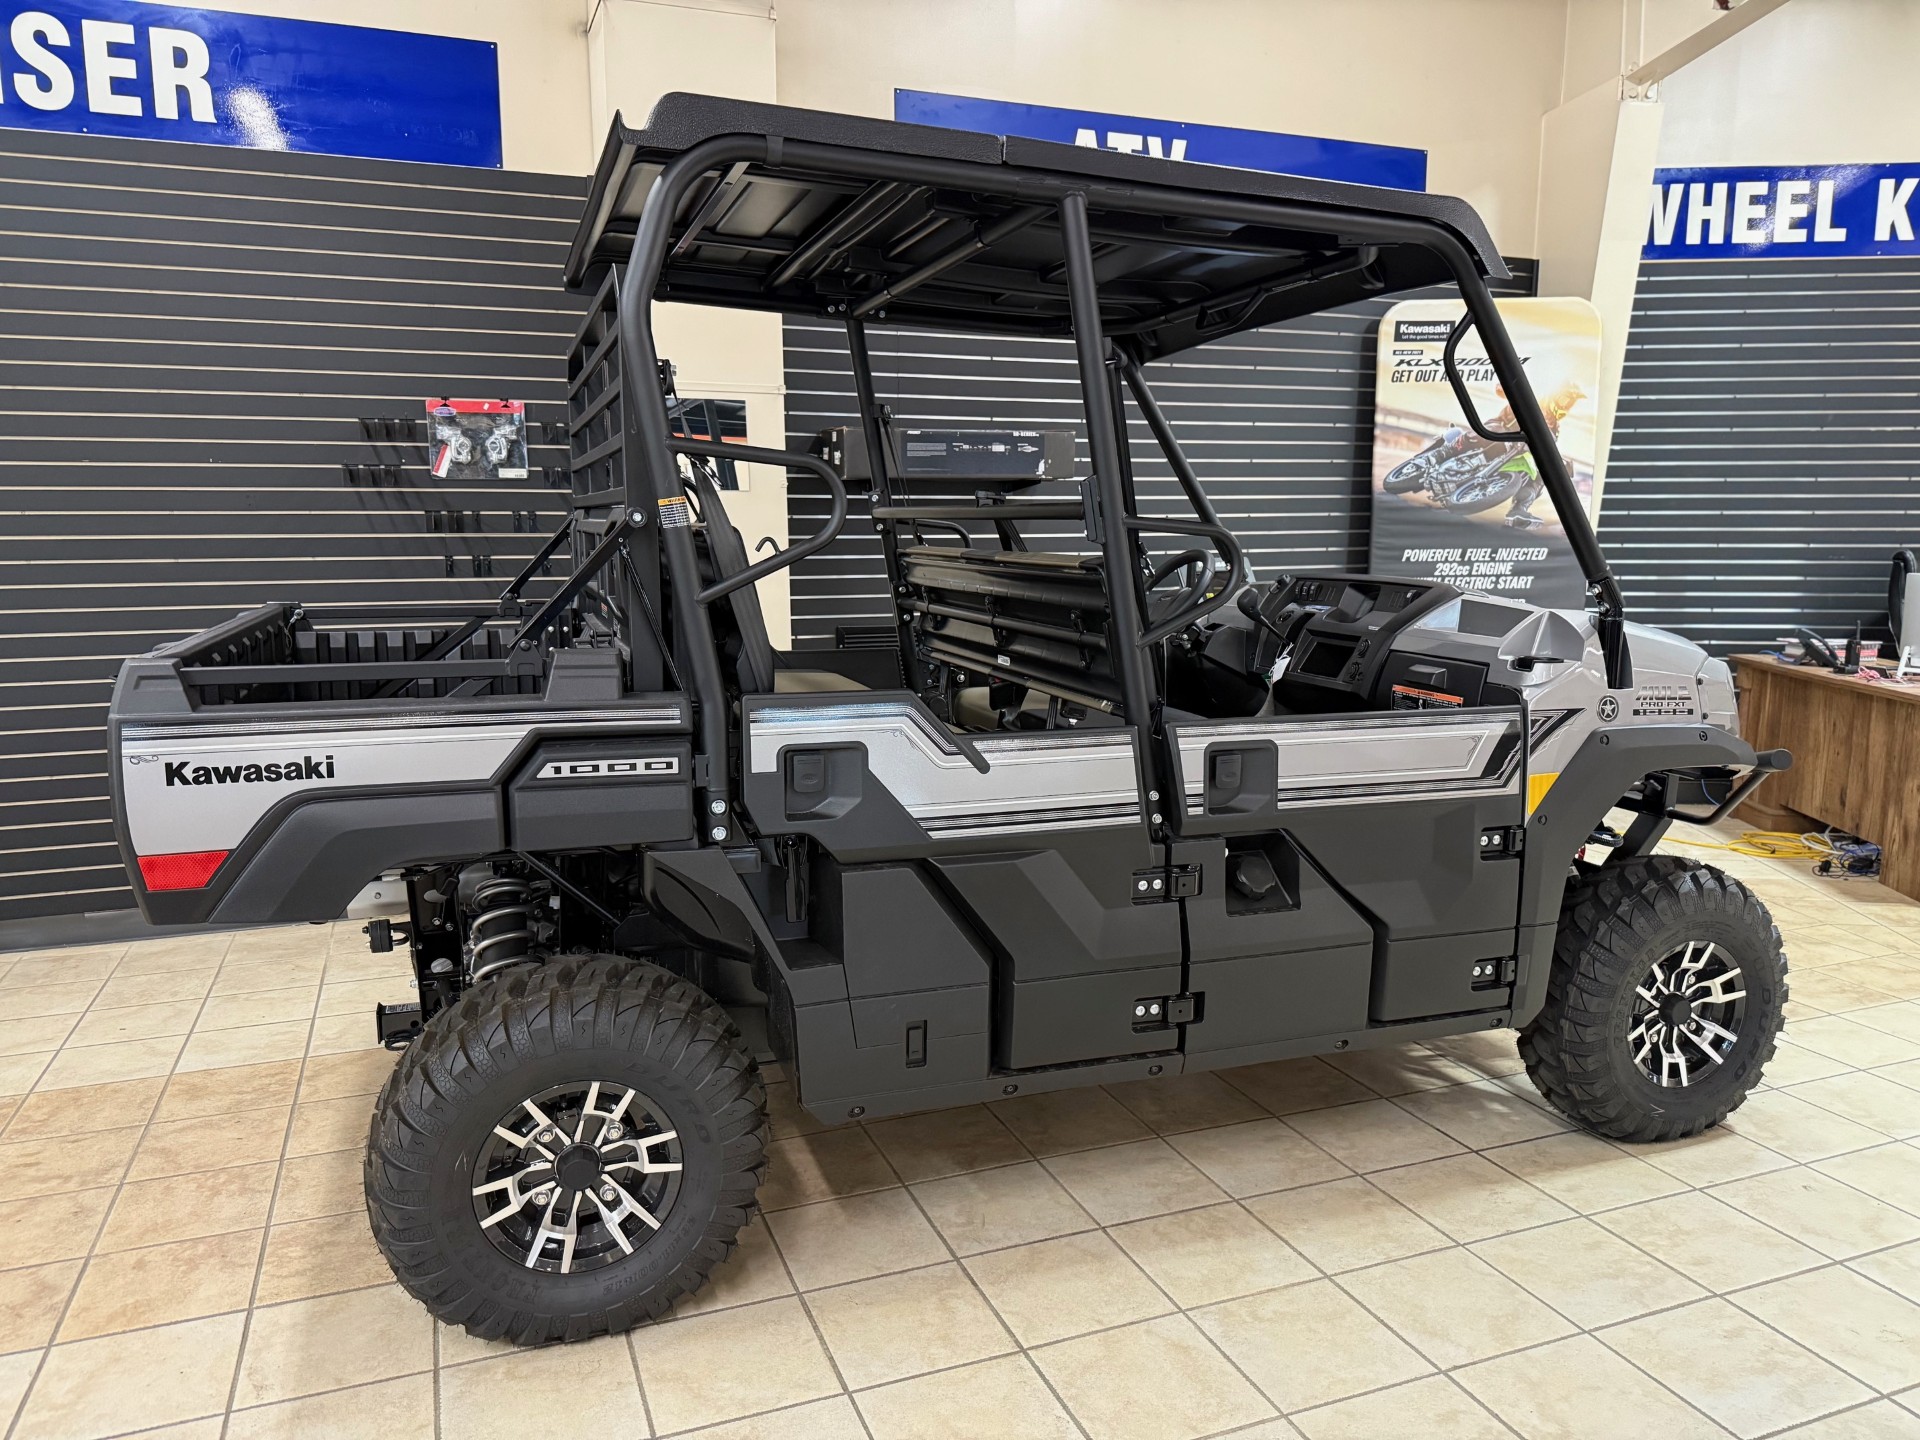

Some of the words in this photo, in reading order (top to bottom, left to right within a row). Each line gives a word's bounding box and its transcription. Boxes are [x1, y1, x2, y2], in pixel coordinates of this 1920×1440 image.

[0, 11, 217, 123] SER
[1642, 179, 1847, 246] WHEEL
[1400, 323, 1451, 334] Kawasaki
[1391, 370, 1414, 383] GET
[1415, 369, 1440, 383] OUT
[1440, 369, 1465, 382] AD
[1466, 368, 1496, 381] PLAY
[1402, 549, 1463, 562] POWERFUL
[1464, 547, 1549, 561] FUEL-INJECTED
[1434, 562, 1470, 576] 292cc
[1471, 562, 1514, 575] ENGINE
[1497, 576, 1535, 589] START
[1635, 686, 1692, 700] MULE
[164, 755, 335, 786] Kawasaki
[551, 761, 673, 774] 1000
